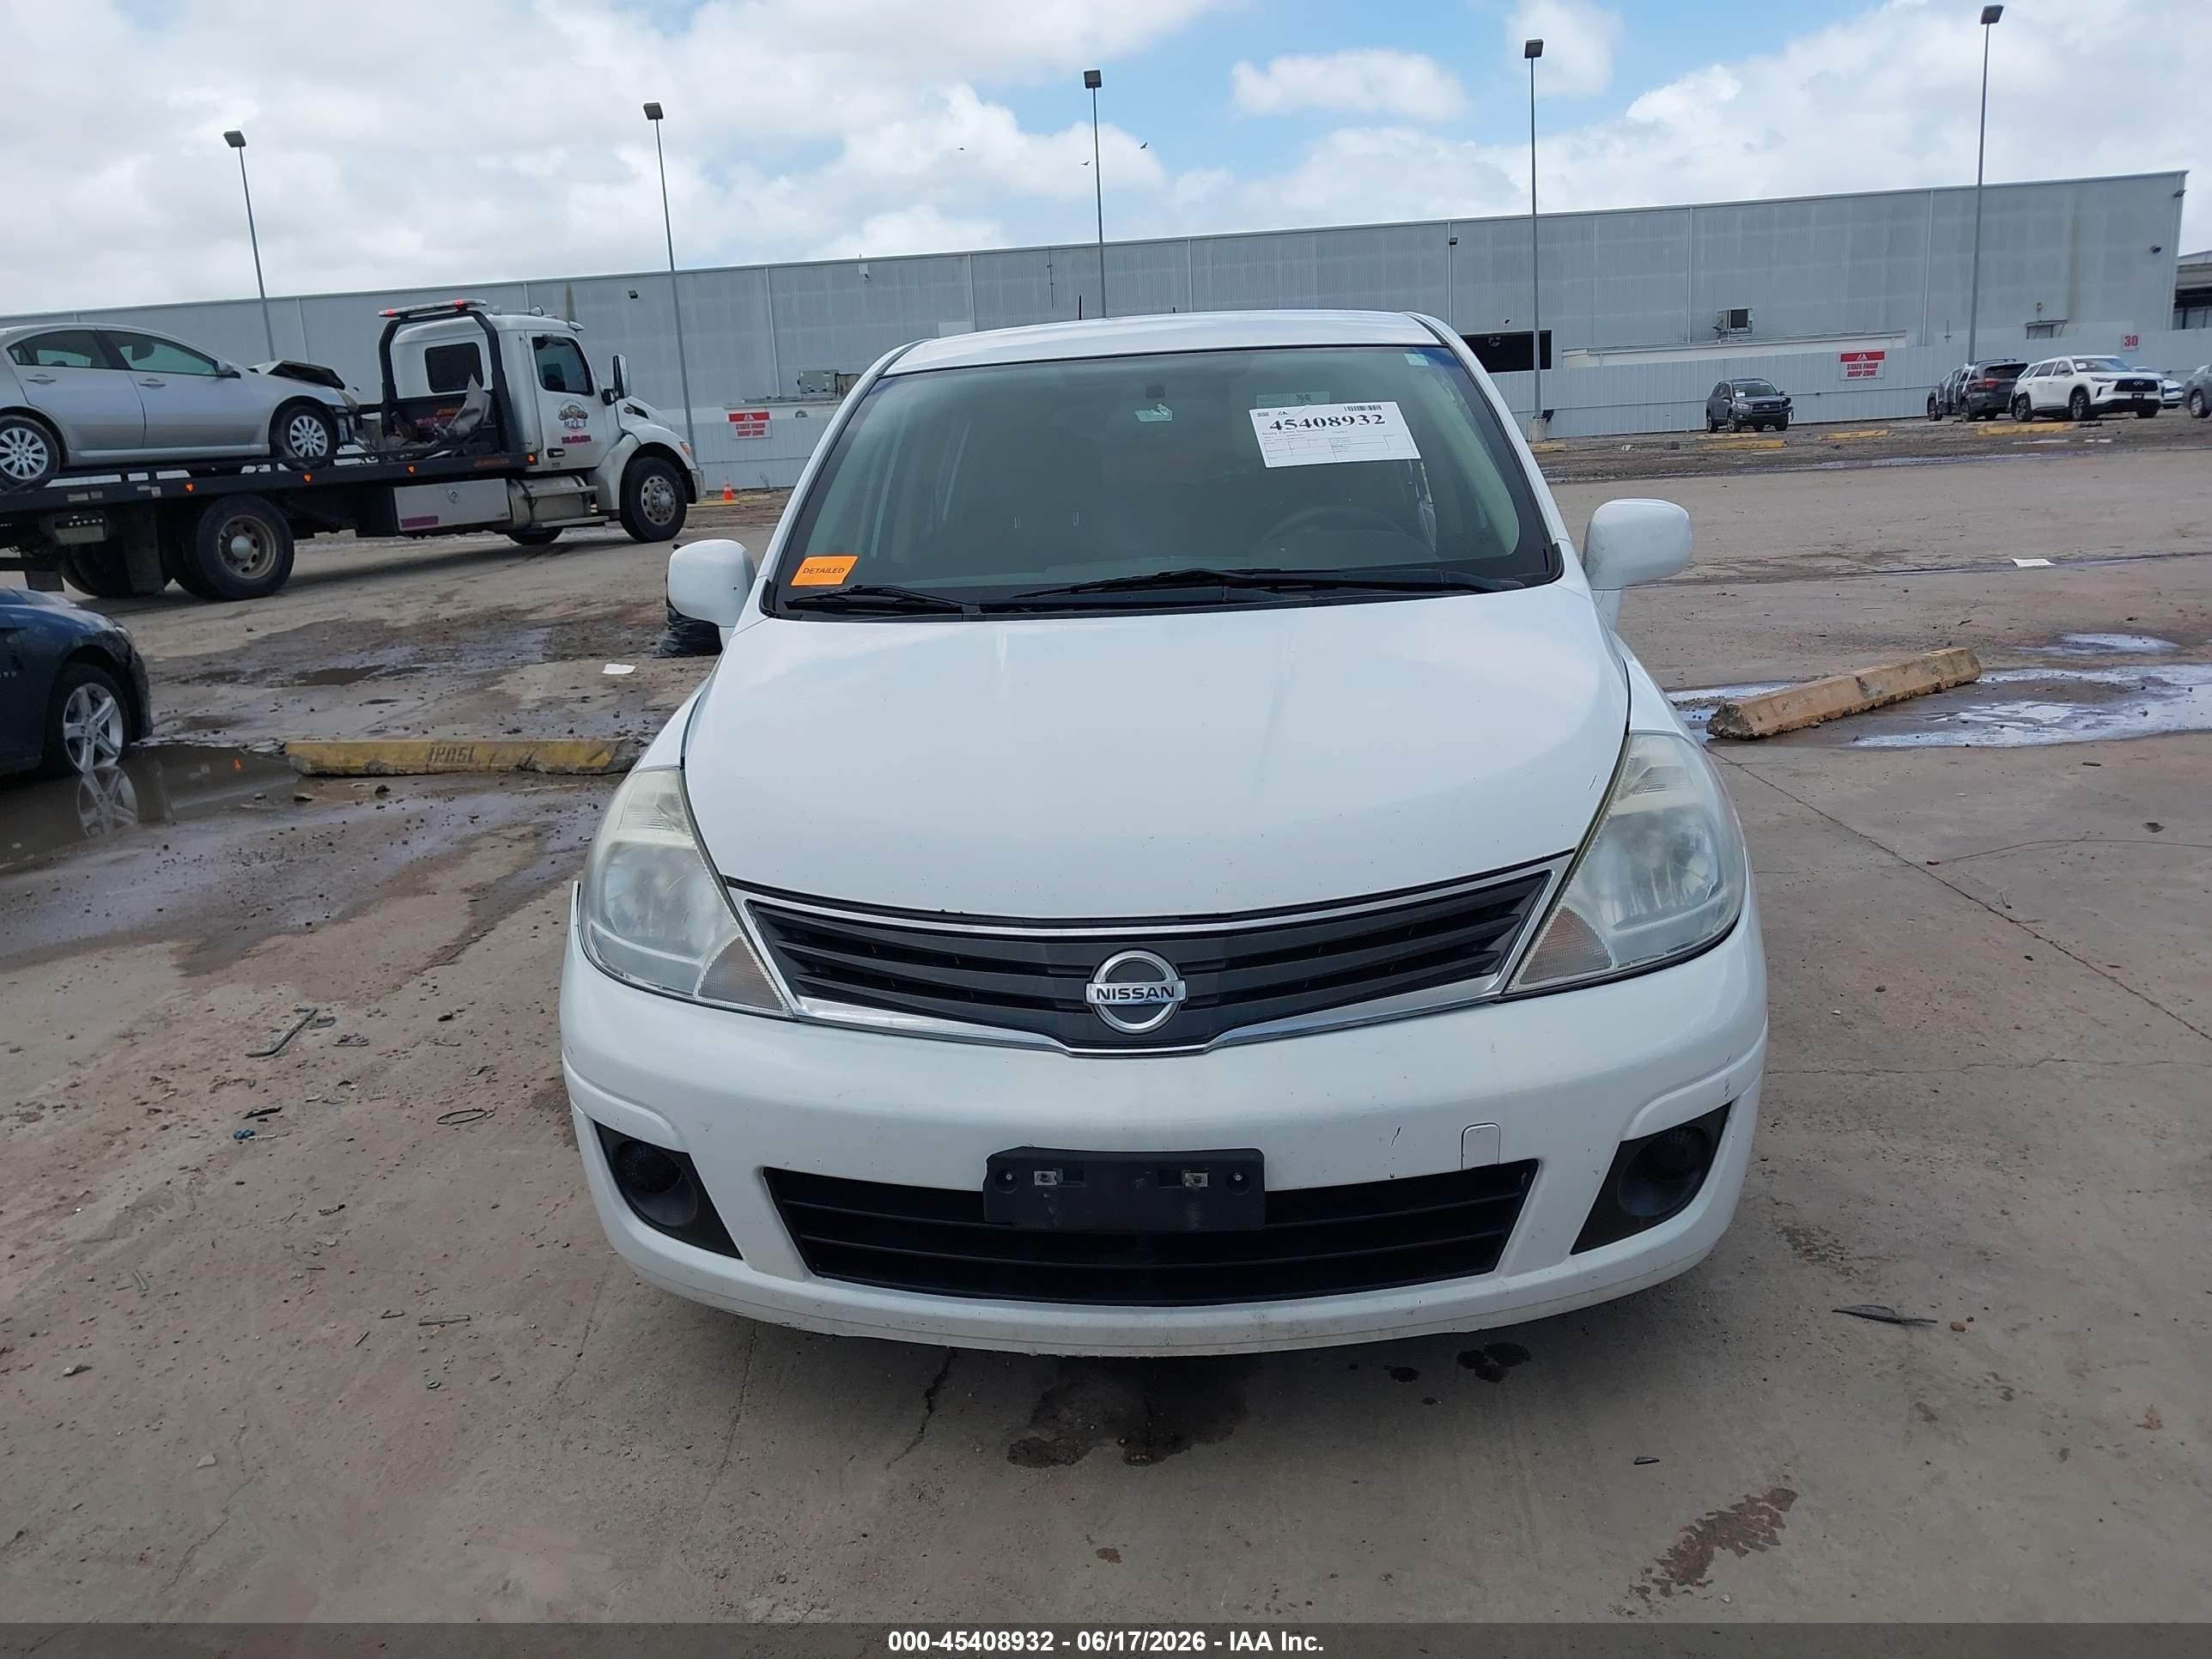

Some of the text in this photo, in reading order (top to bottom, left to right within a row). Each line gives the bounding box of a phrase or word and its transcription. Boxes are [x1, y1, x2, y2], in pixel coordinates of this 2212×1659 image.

[2124, 335, 2138, 347] 30
[1269, 414, 1385, 430] 45408932
[1096, 986, 1175, 1000] NISSAN
